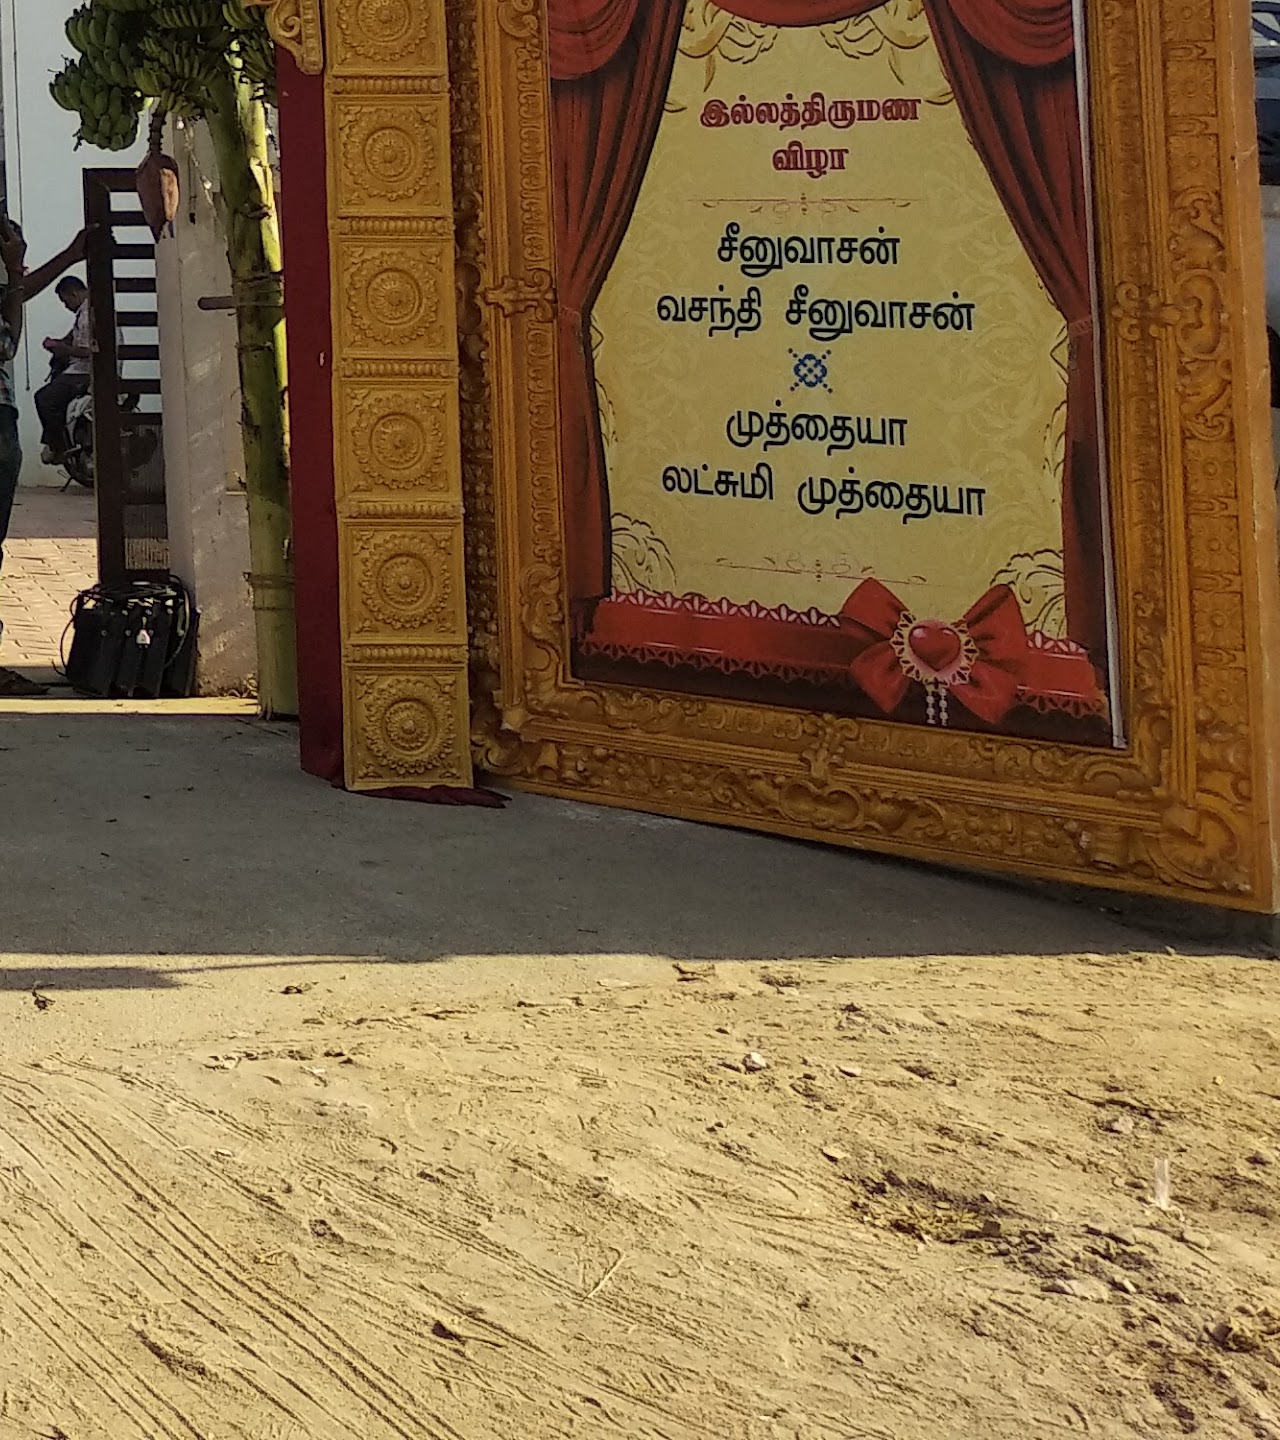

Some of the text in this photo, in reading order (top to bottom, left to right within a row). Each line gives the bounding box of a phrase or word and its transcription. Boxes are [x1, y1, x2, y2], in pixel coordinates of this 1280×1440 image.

[700, 92, 921, 130] இல்லத்திருமண
[773, 140, 849, 178] விழா
[717, 221, 901, 277] சீனுவாசன்
[657, 284, 975, 342] வசந்தி சீனுவாசன்
[726, 399, 908, 456] முத்தையா
[663, 462, 986, 525] லட்சுமி முத்தையா
